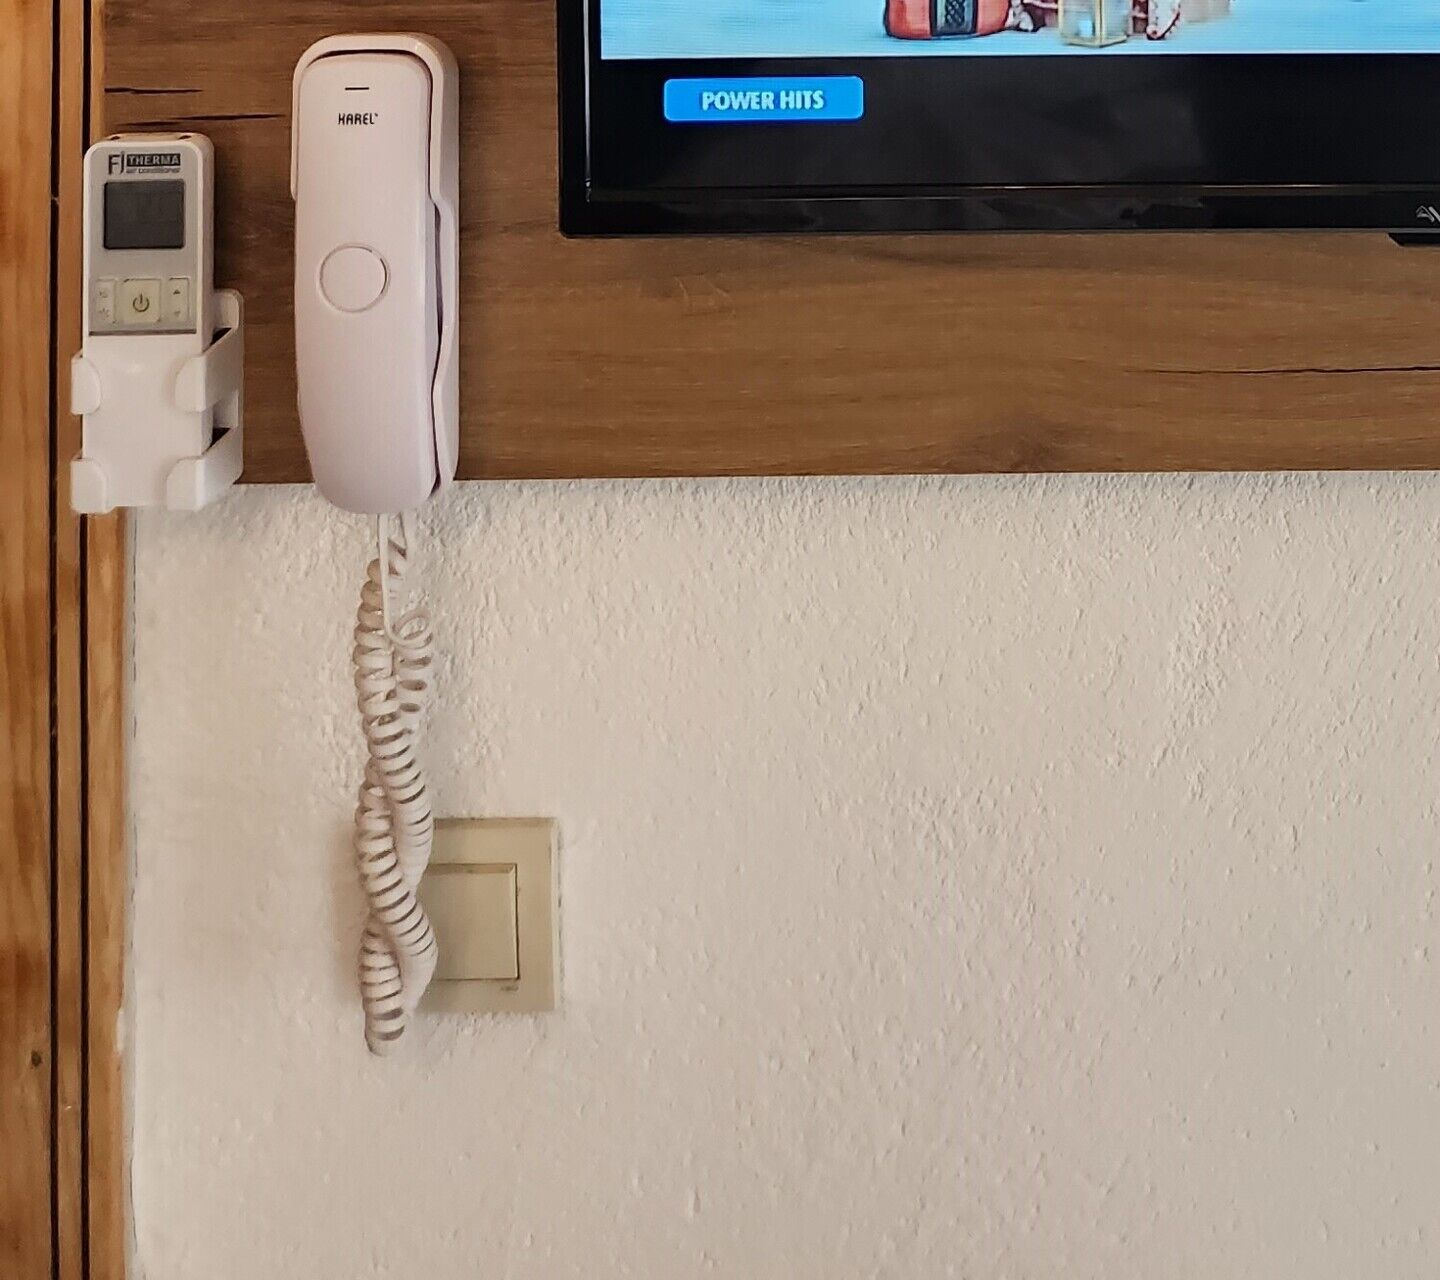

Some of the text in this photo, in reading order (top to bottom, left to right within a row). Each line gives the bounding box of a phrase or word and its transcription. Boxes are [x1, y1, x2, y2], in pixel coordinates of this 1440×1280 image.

[702, 90, 824, 111] POWER HITS
[338, 112, 375, 126] KAREL
[128, 154, 180, 166] THERMA
